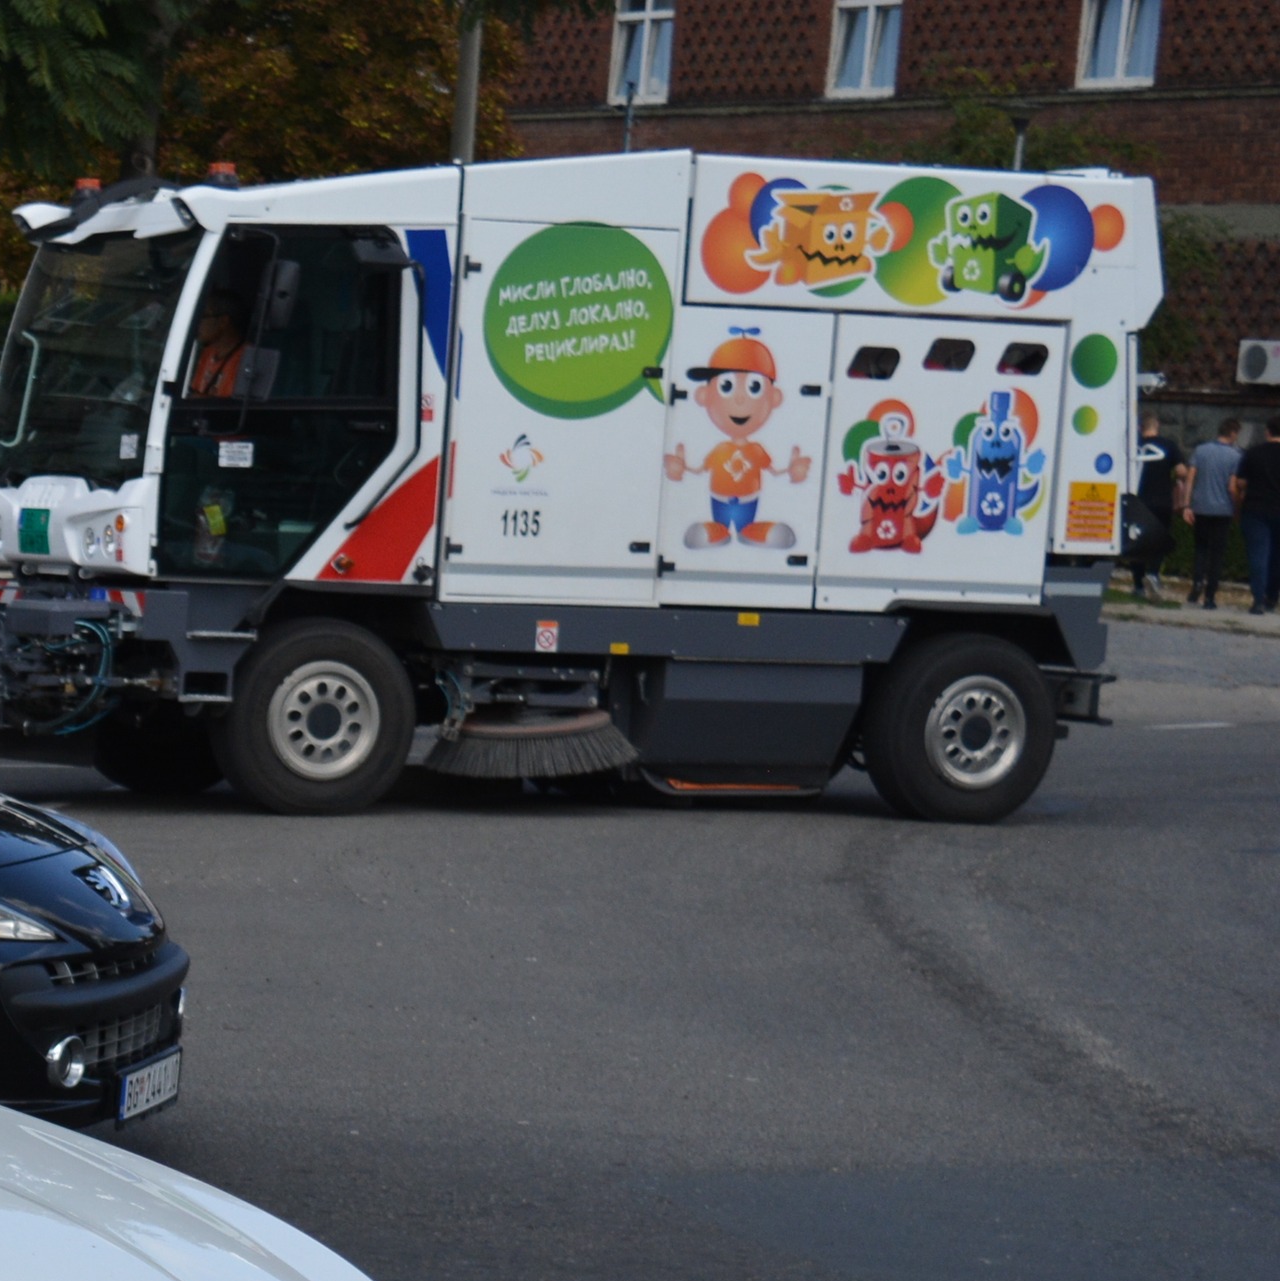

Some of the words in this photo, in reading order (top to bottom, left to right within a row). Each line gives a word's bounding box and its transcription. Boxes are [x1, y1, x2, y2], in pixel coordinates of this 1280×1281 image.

[498, 280, 556, 306] МИСЛИ
[560, 268, 652, 298] ГЛОБАЛНО,
[505, 309, 560, 336] ДЕЛУЈ
[565, 299, 650, 327] ЛОКАЛНО,
[524, 329, 636, 363] РЕЦИКЛИРАЈ!
[501, 509, 541, 536] 1135
